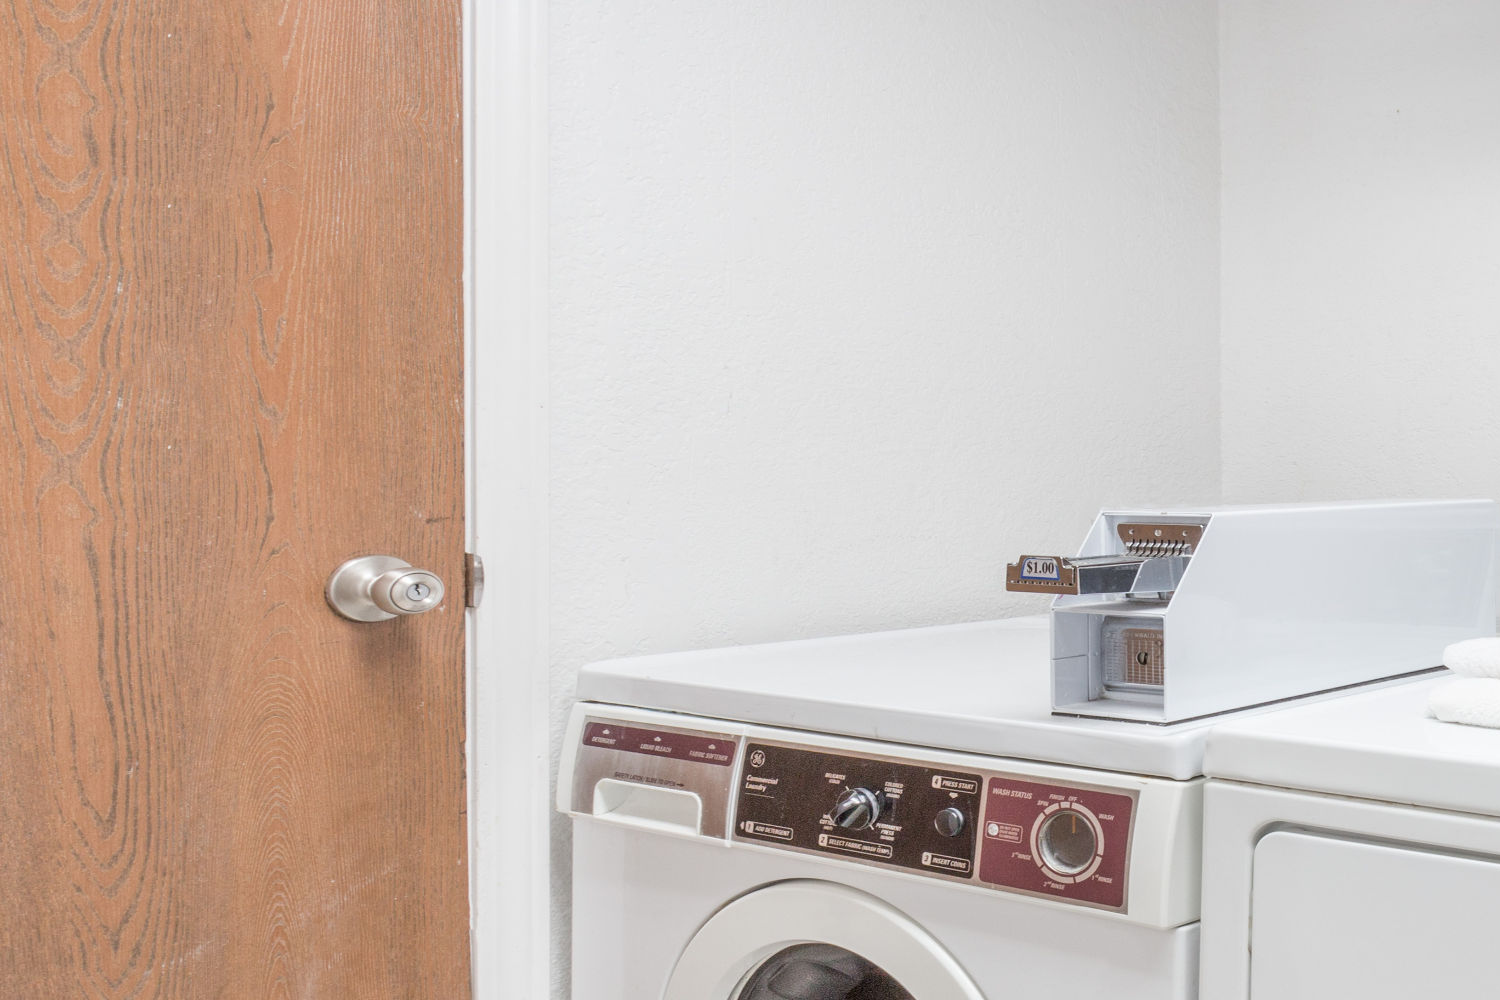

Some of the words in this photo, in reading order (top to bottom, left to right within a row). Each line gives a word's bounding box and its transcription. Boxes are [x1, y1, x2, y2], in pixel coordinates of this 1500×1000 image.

[1026, 561, 1055, 575] $1.00
[745, 782, 767, 792] Laundry
[942, 780, 958, 788] PRESS
[958, 782, 975, 790] START
[992, 787, 1011, 797] WASH
[1011, 790, 1033, 800] STATUS
[1098, 813, 1115, 821] WASH
[755, 825, 765, 833] ADD
[765, 827, 790, 837] DETERGENT
[932, 856, 950, 867] INSERT
[950, 860, 967, 869] COINS
